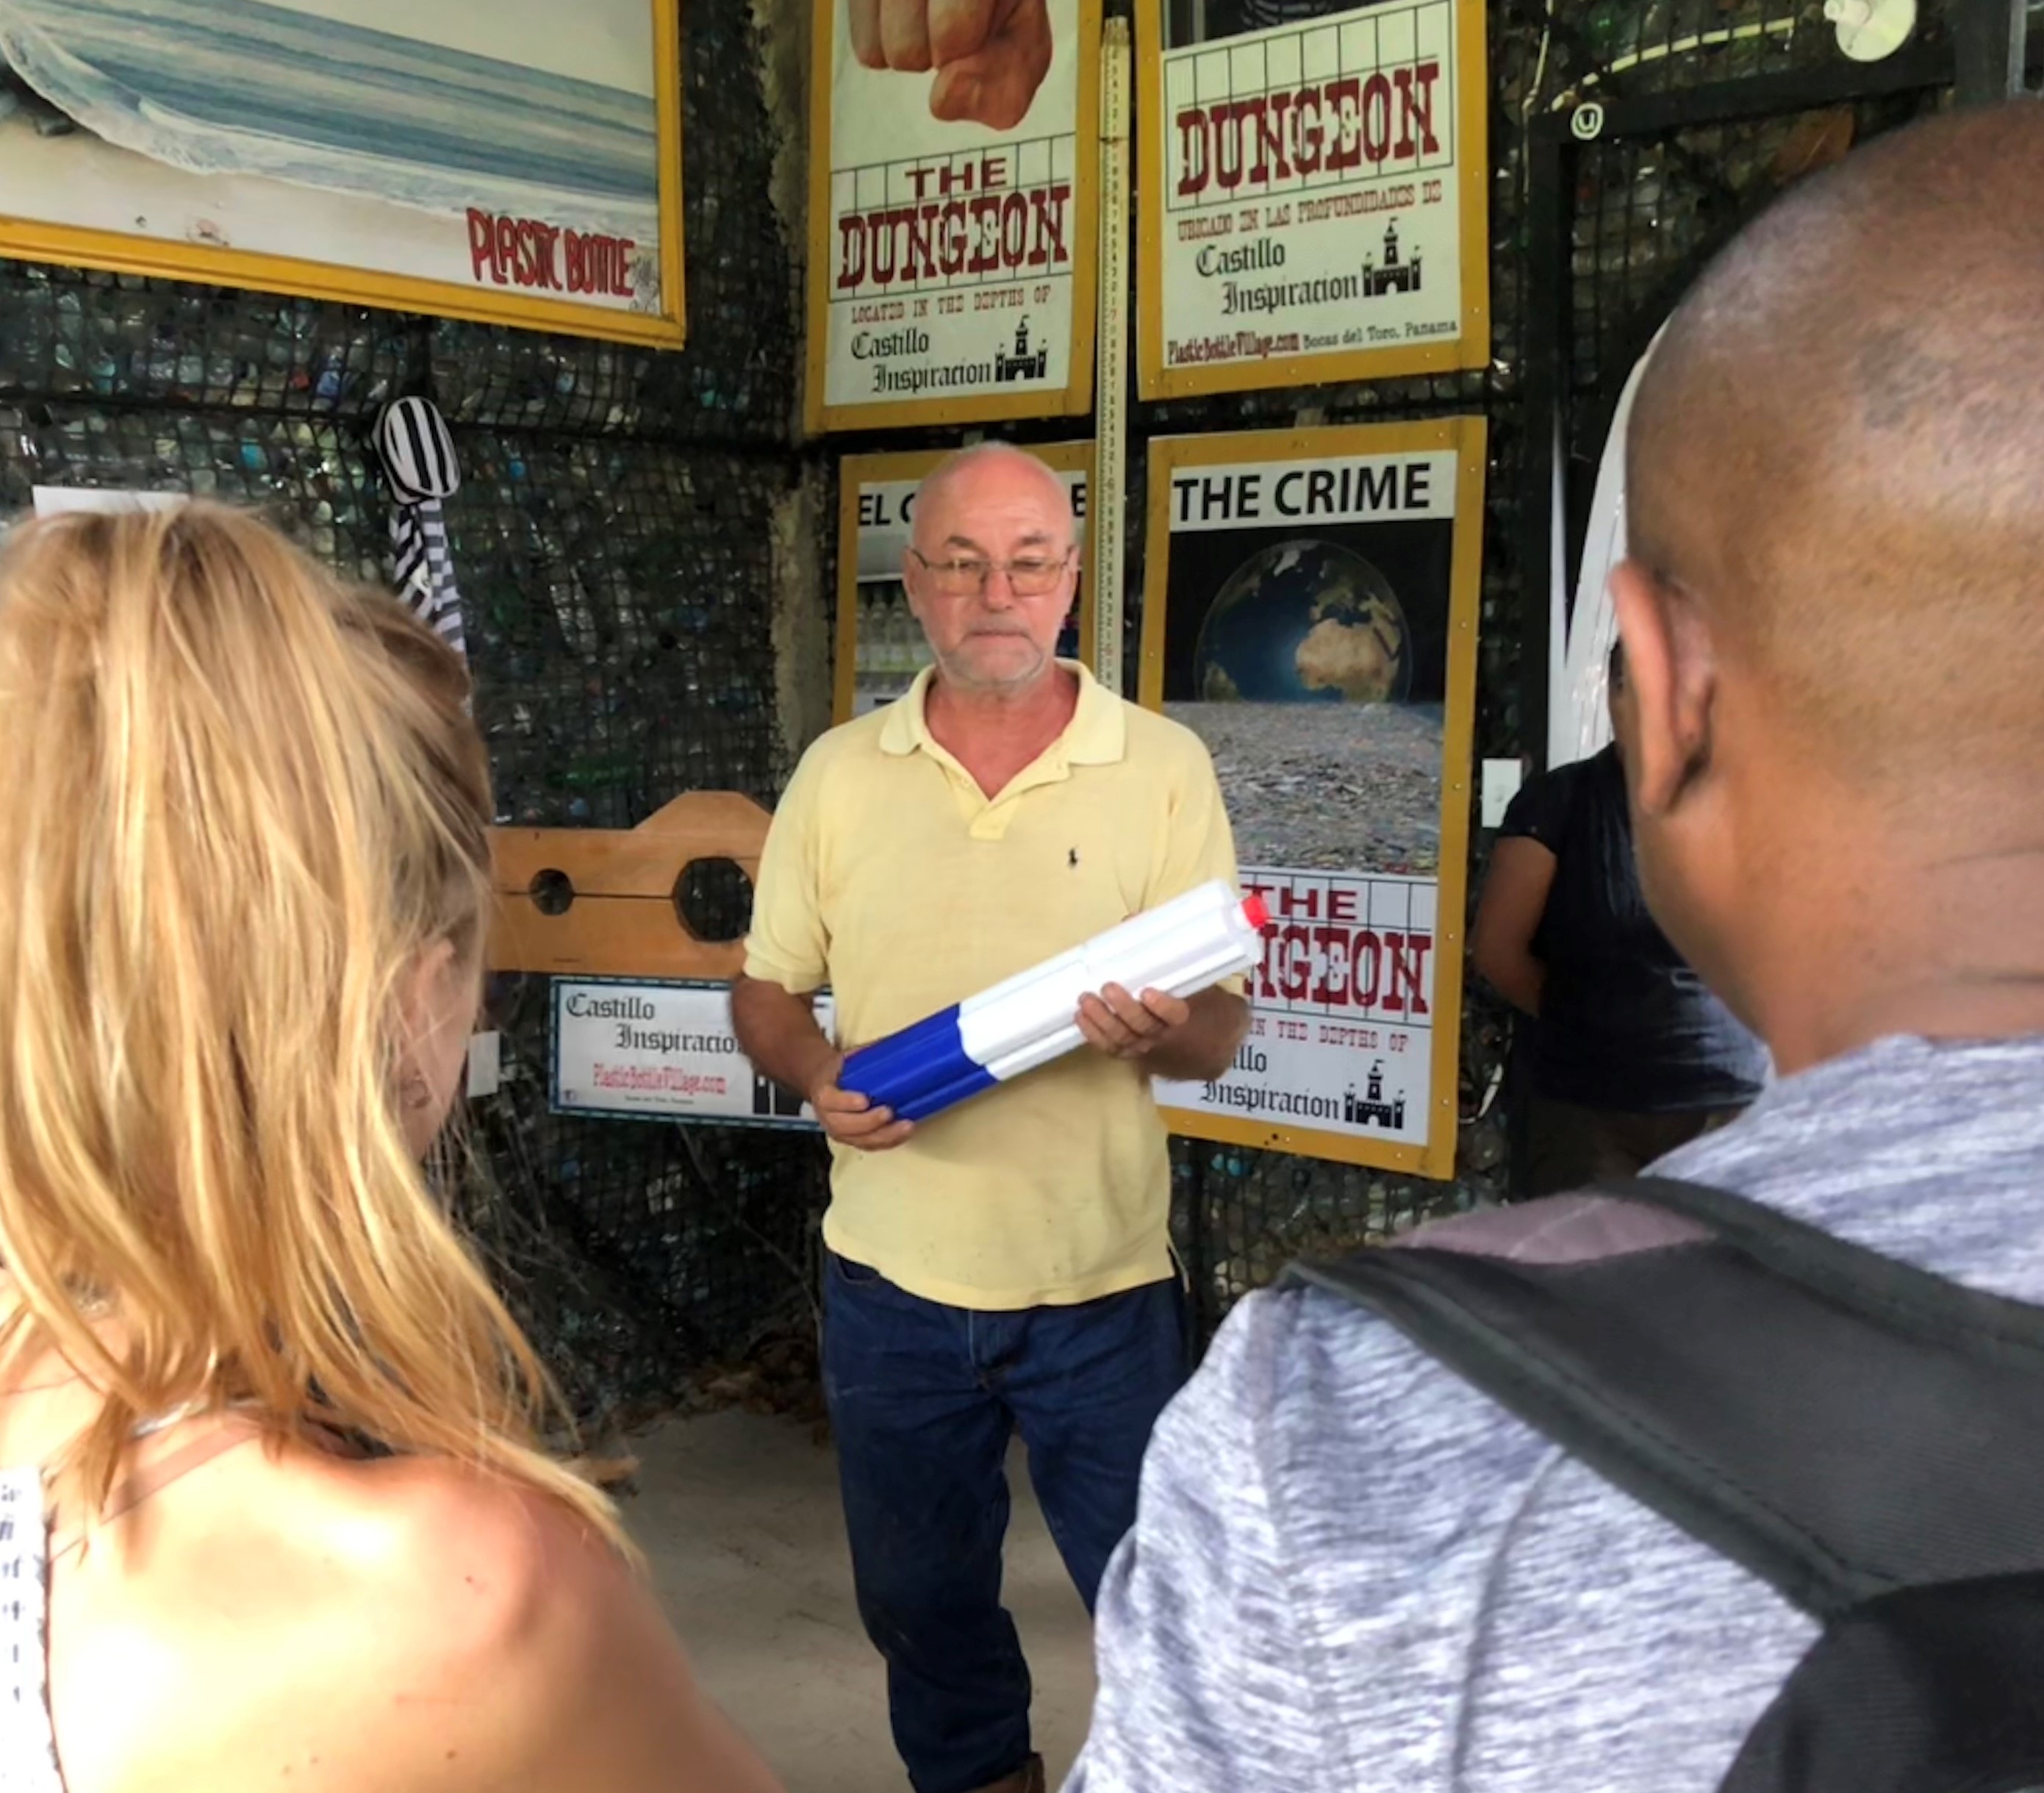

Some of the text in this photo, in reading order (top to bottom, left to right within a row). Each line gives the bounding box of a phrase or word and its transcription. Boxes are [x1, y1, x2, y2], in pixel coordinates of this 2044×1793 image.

[1177, 62, 1439, 197] DUNGEON
[905, 157, 1007, 197] THE
[1177, 213, 1233, 241] UBICADO
[1266, 204, 1291, 228] LAS
[1298, 184, 1415, 223] PROFUNDIDADES
[1423, 179, 1442, 204] DE
[466, 207, 635, 297] PLASTIC BOTTLE
[837, 185, 1070, 289] DUNGEON
[1196, 237, 1285, 277] Castillo
[851, 284, 1050, 323] LOCATED IN THE DEPTHS OF
[1221, 273, 1358, 315] Inspiracion
[851, 329, 929, 359] Castillo
[1303, 333, 1338, 349] Bocas
[1342, 328, 1363, 343] del
[1405, 318, 1457, 337] Panama
[872, 359, 991, 393] Inspiracion
[858, 494, 891, 526] EL
[1174, 462, 1430, 521] THE CRIME
[567, 992, 655, 1021] Castillo
[615, 1023, 741, 1054] Inspiracio
[1390, 1033, 1408, 1053] OF
[1200, 1080, 1339, 1120] Inspiracion
